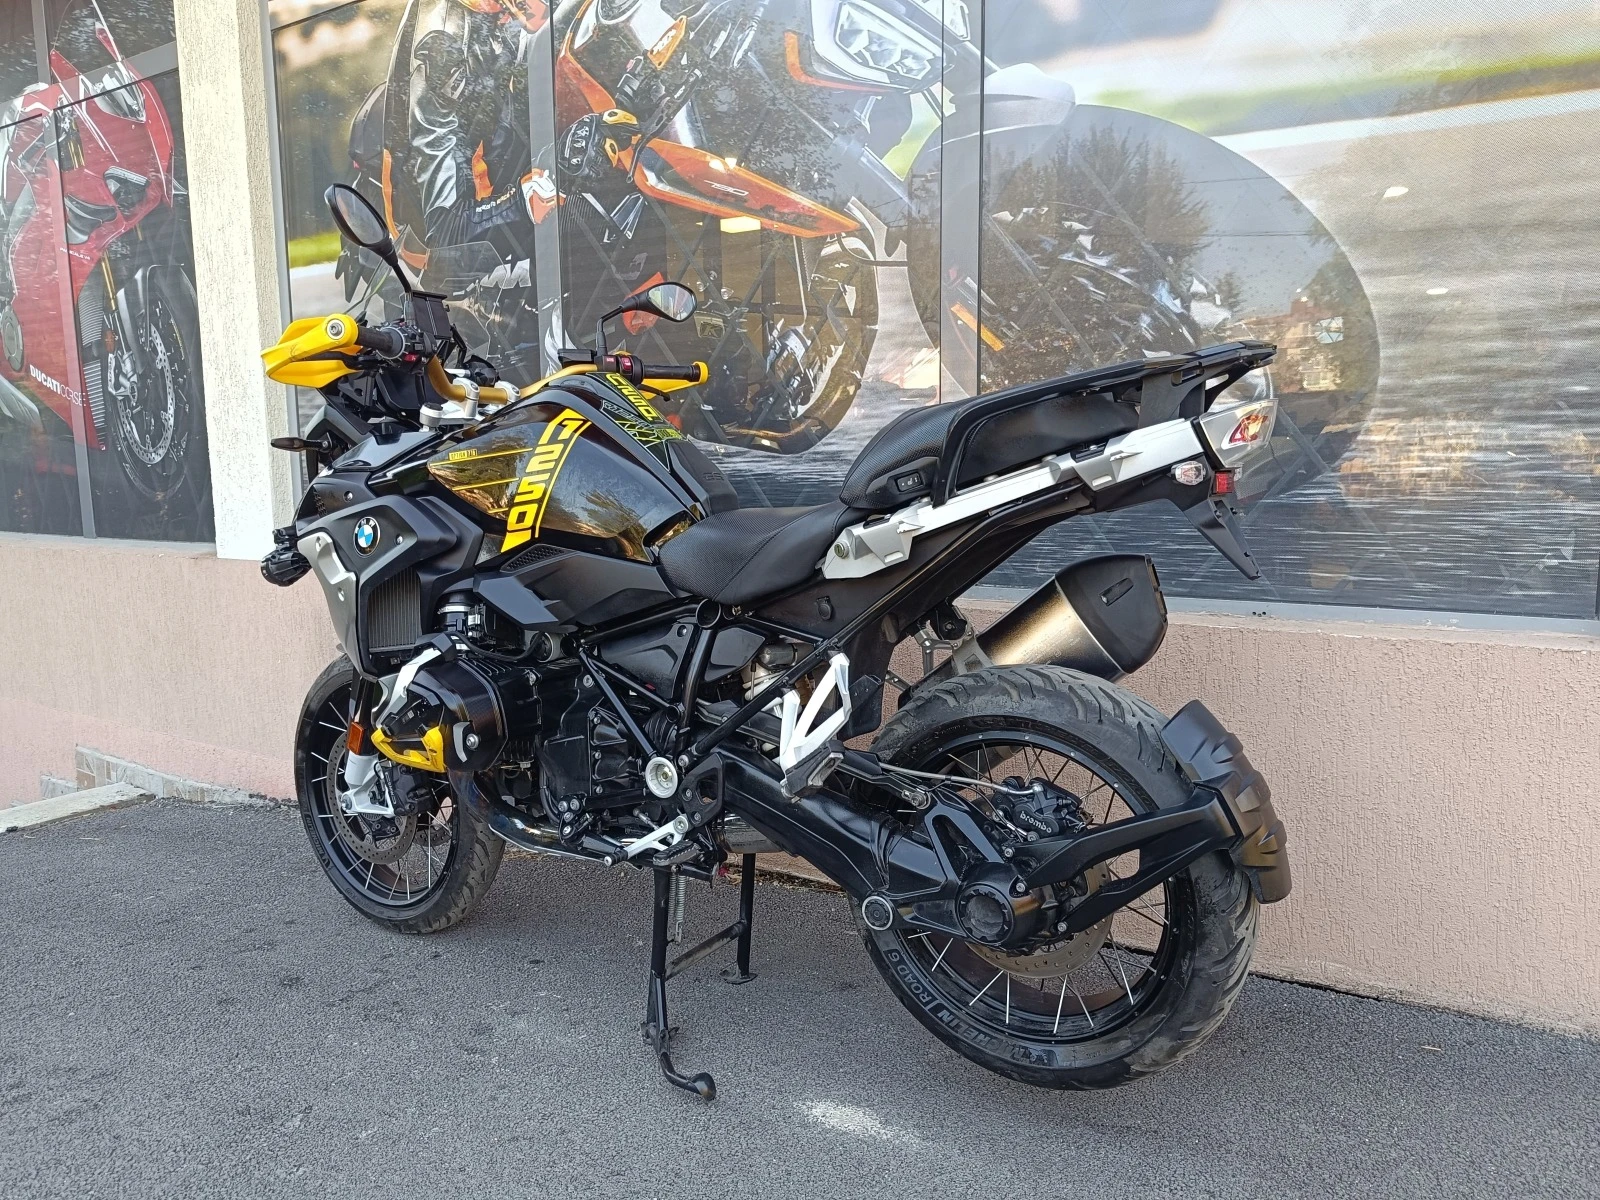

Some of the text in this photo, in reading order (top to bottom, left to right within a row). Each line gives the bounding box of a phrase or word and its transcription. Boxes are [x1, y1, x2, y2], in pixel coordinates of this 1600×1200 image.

[29, 363, 60, 395] DUCATI
[506, 418, 585, 533] 1250
[1020, 810, 1052, 834] brembo
[887, 951, 900, 963] 6
[896, 964, 932, 1002] ROAD
